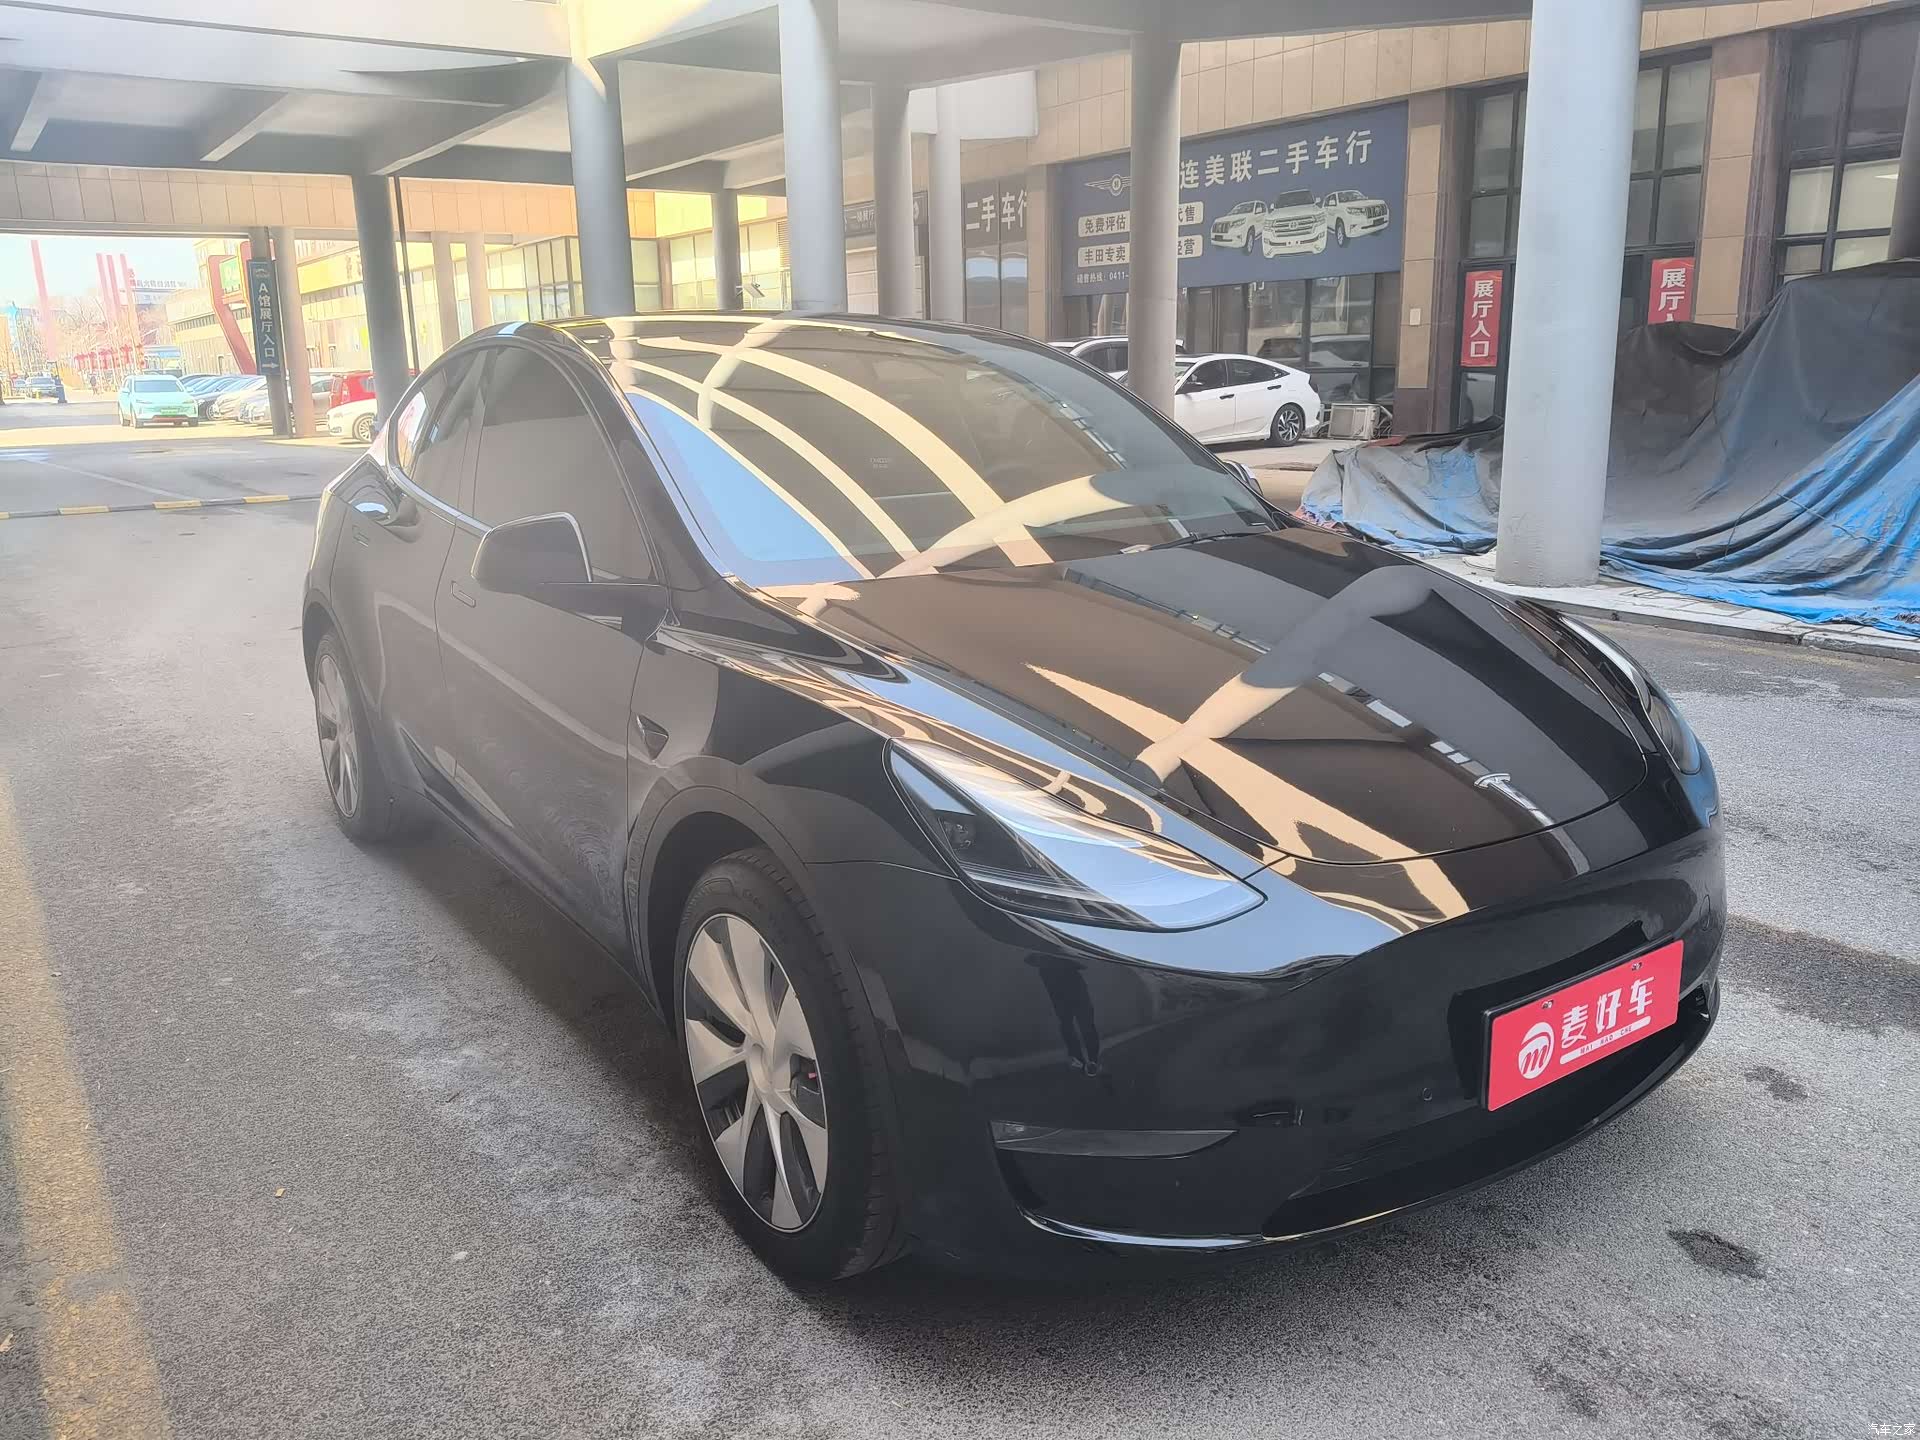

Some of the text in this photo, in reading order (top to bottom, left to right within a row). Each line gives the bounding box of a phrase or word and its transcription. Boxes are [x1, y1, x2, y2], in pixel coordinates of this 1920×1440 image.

[1179, 129, 1372, 190] 连美联二手车行
[1085, 213, 1126, 234] 免费评估
[1085, 245, 1126, 264] 丰田专卖
[258, 282, 275, 358] A馆展厅入口
[1470, 280, 1494, 358] 展厅入口
[1658, 267, 1686, 322] 展厅
[1561, 976, 1655, 1049] 麦好车
